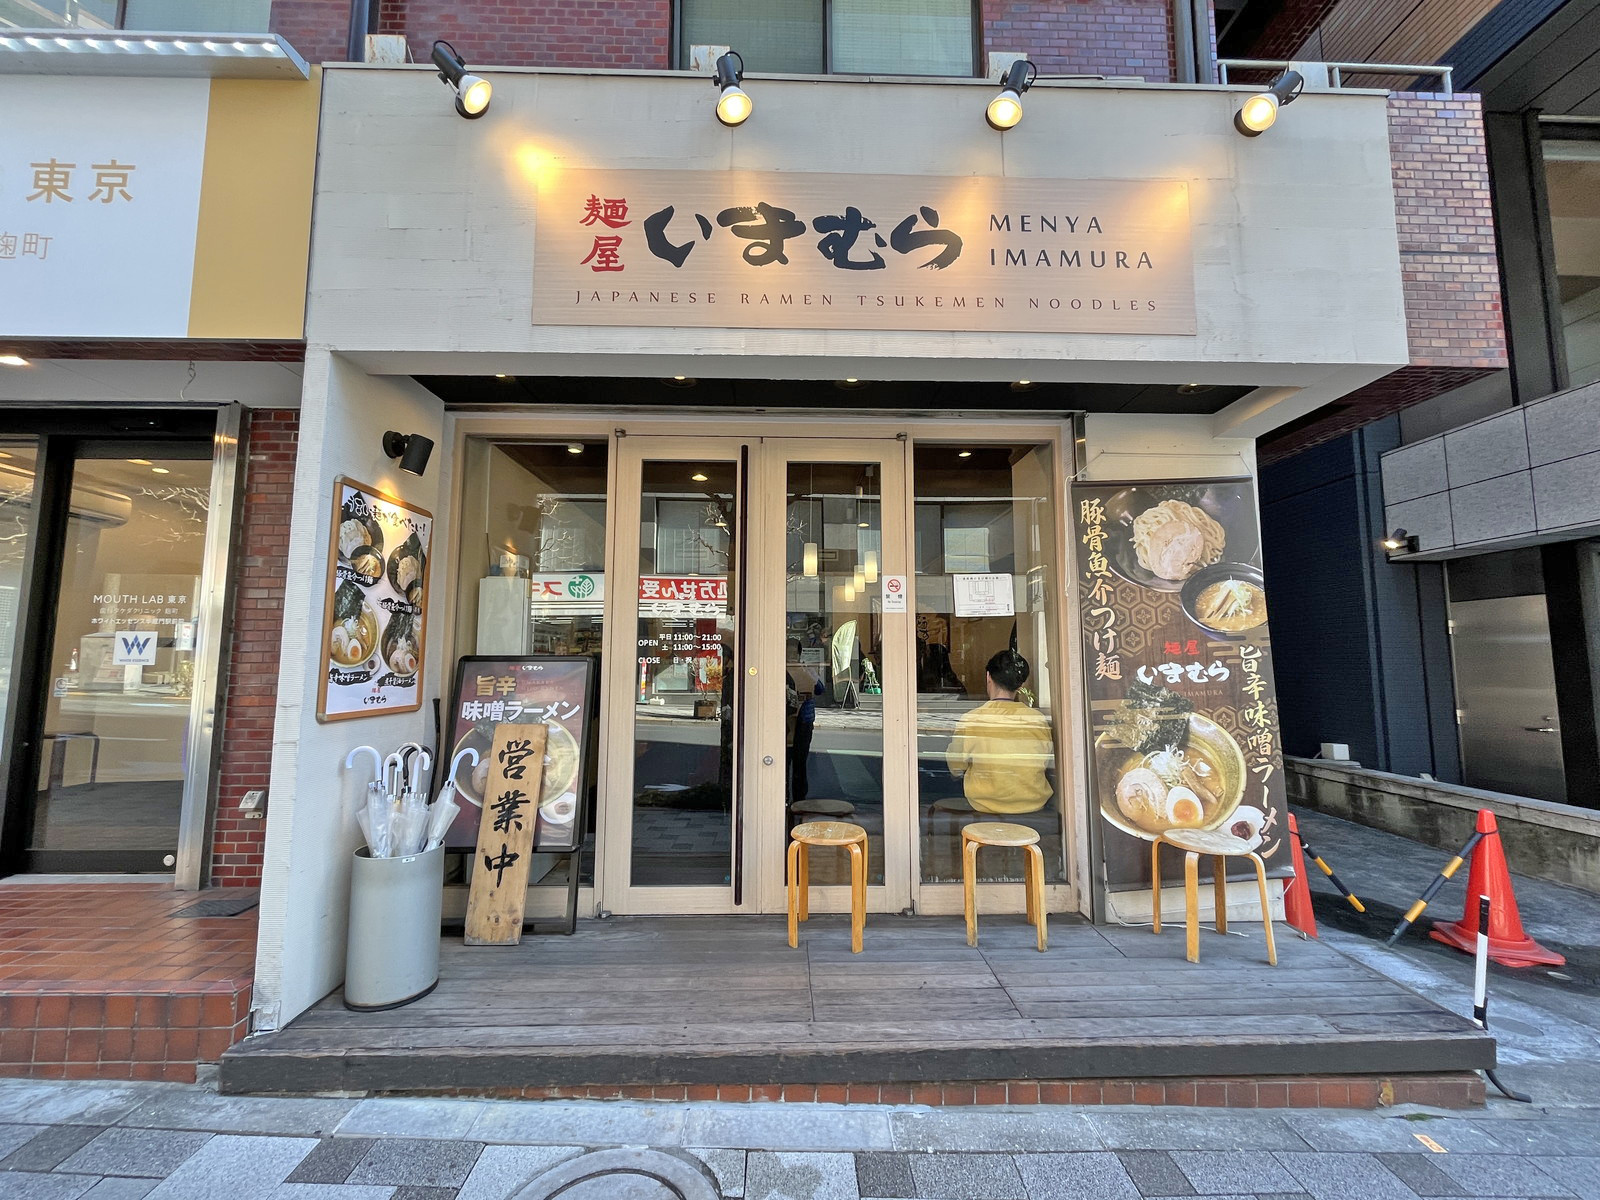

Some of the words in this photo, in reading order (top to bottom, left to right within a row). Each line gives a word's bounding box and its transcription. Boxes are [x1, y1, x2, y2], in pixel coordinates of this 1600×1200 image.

[26, 157, 137, 204] 東京
[579, 193, 632, 272] 麺屋
[643, 201, 963, 271] いまむら
[989, 214, 1103, 234] MENYA
[990, 248, 1153, 269] IMAMURA
[575, 290, 716, 304] JAPANESE
[740, 292, 832, 306] RAMEN
[856, 294, 1004, 308] TSUKEMEN
[1029, 297, 1156, 311] NOODLES
[93, 594, 138, 604] MOUTH
[141, 595, 164, 604] LAB
[167, 595, 187, 605] 東京
[1081, 498, 1123, 681] 豚骨魚介つけ麺
[638, 639, 659, 647] OPEN
[661, 643, 669, 651] 土
[638, 656, 661, 664] CLOSE
[1137, 660, 1230, 685] いまむら
[476, 675, 517, 696] 旨辛
[1184, 689, 1224, 697] IMAMURA
[461, 700, 581, 722] 味噌ラーメン
[1239, 645, 1282, 859] 旨辛味噌ラーメン
[484, 740, 534, 888] 営業中
